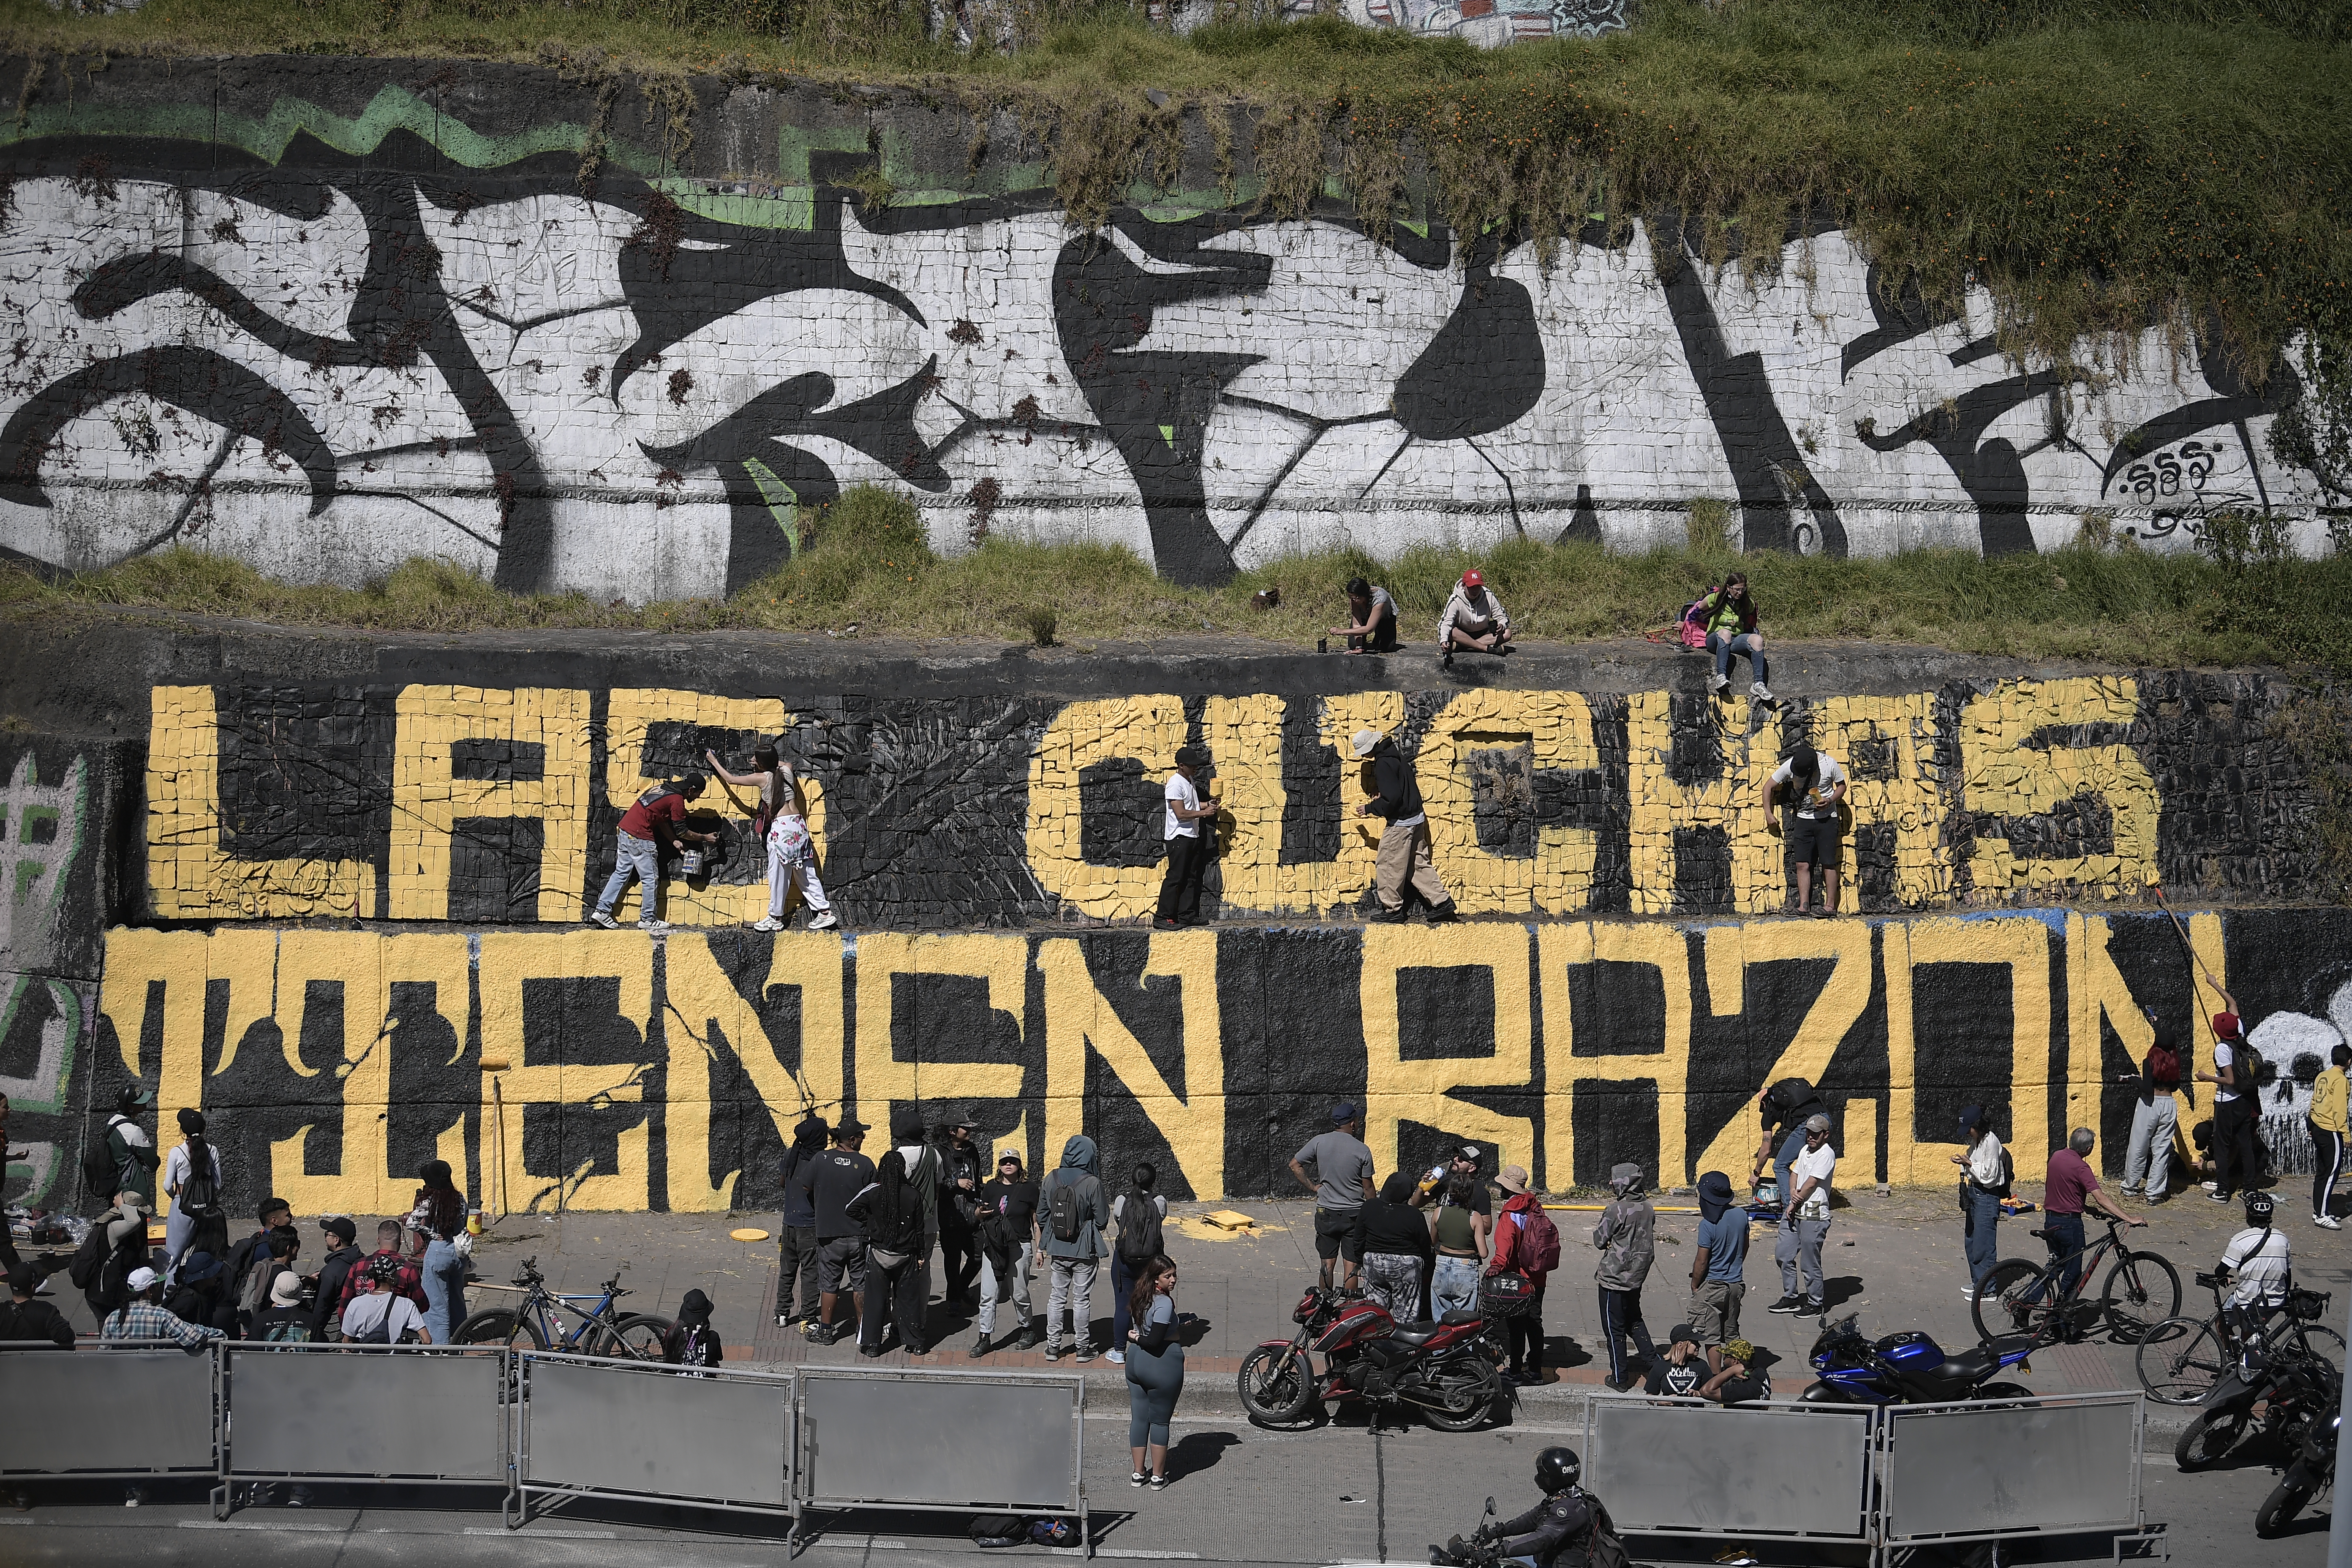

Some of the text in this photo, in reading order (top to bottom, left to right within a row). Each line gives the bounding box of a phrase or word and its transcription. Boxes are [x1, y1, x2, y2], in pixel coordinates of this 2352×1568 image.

[145, 675, 2161, 925] LAS CUCHAS
[100, 924, 1225, 1216] TIENEN
[1359, 910, 2227, 1195] RAZON
